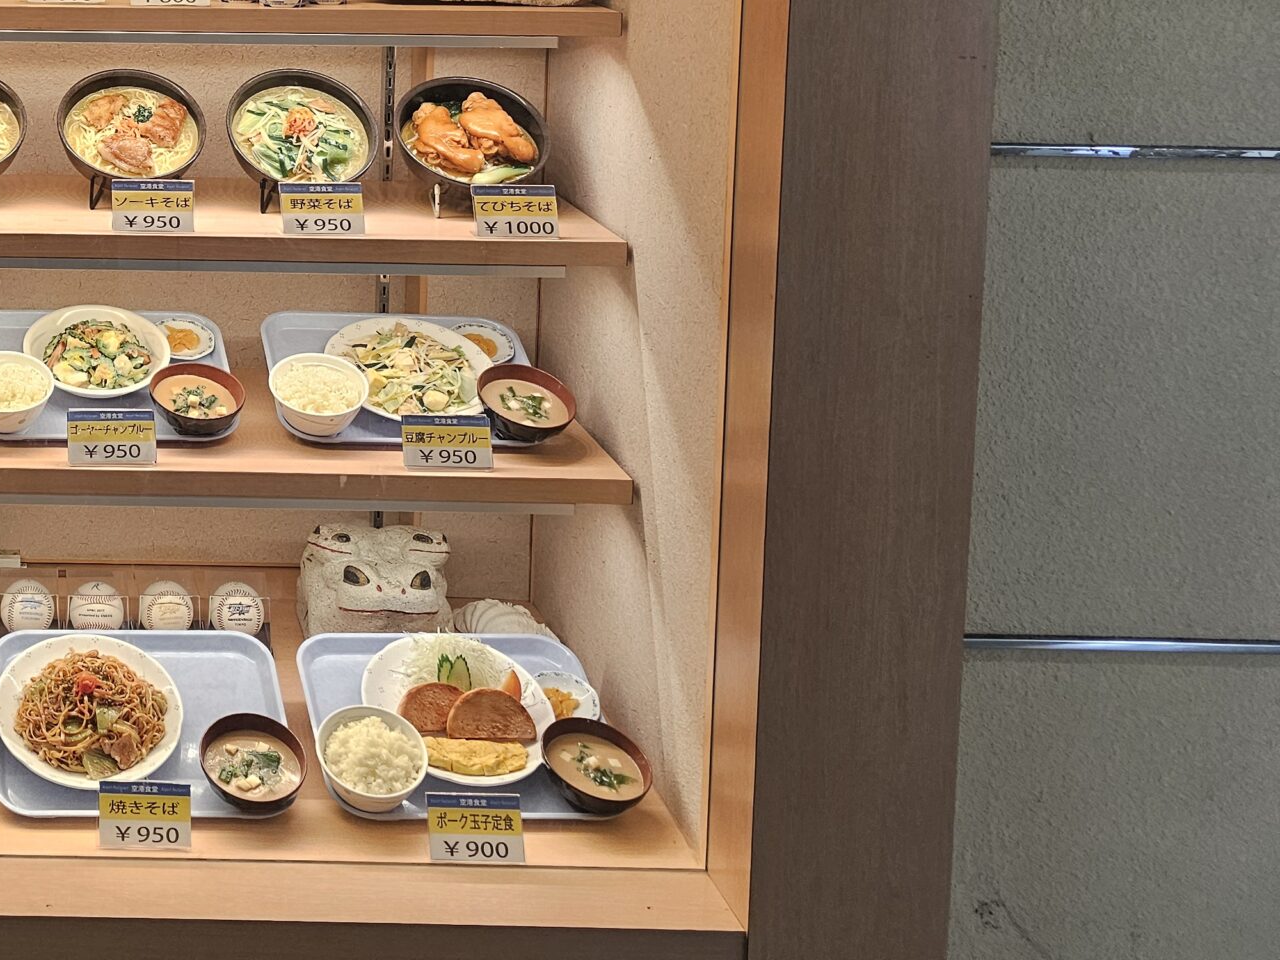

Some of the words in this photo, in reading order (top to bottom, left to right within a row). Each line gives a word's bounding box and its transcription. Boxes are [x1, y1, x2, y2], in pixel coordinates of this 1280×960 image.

[114, 196, 192, 208] ソーキそば
[290, 198, 353, 210] 野菜そば
[477, 200, 553, 212] てびちそば
[405, 431, 488, 444] 豆腐チャンプルー
[108, 799, 179, 816] 焼きそば
[435, 813, 515, 831] ポーク玉子定食
